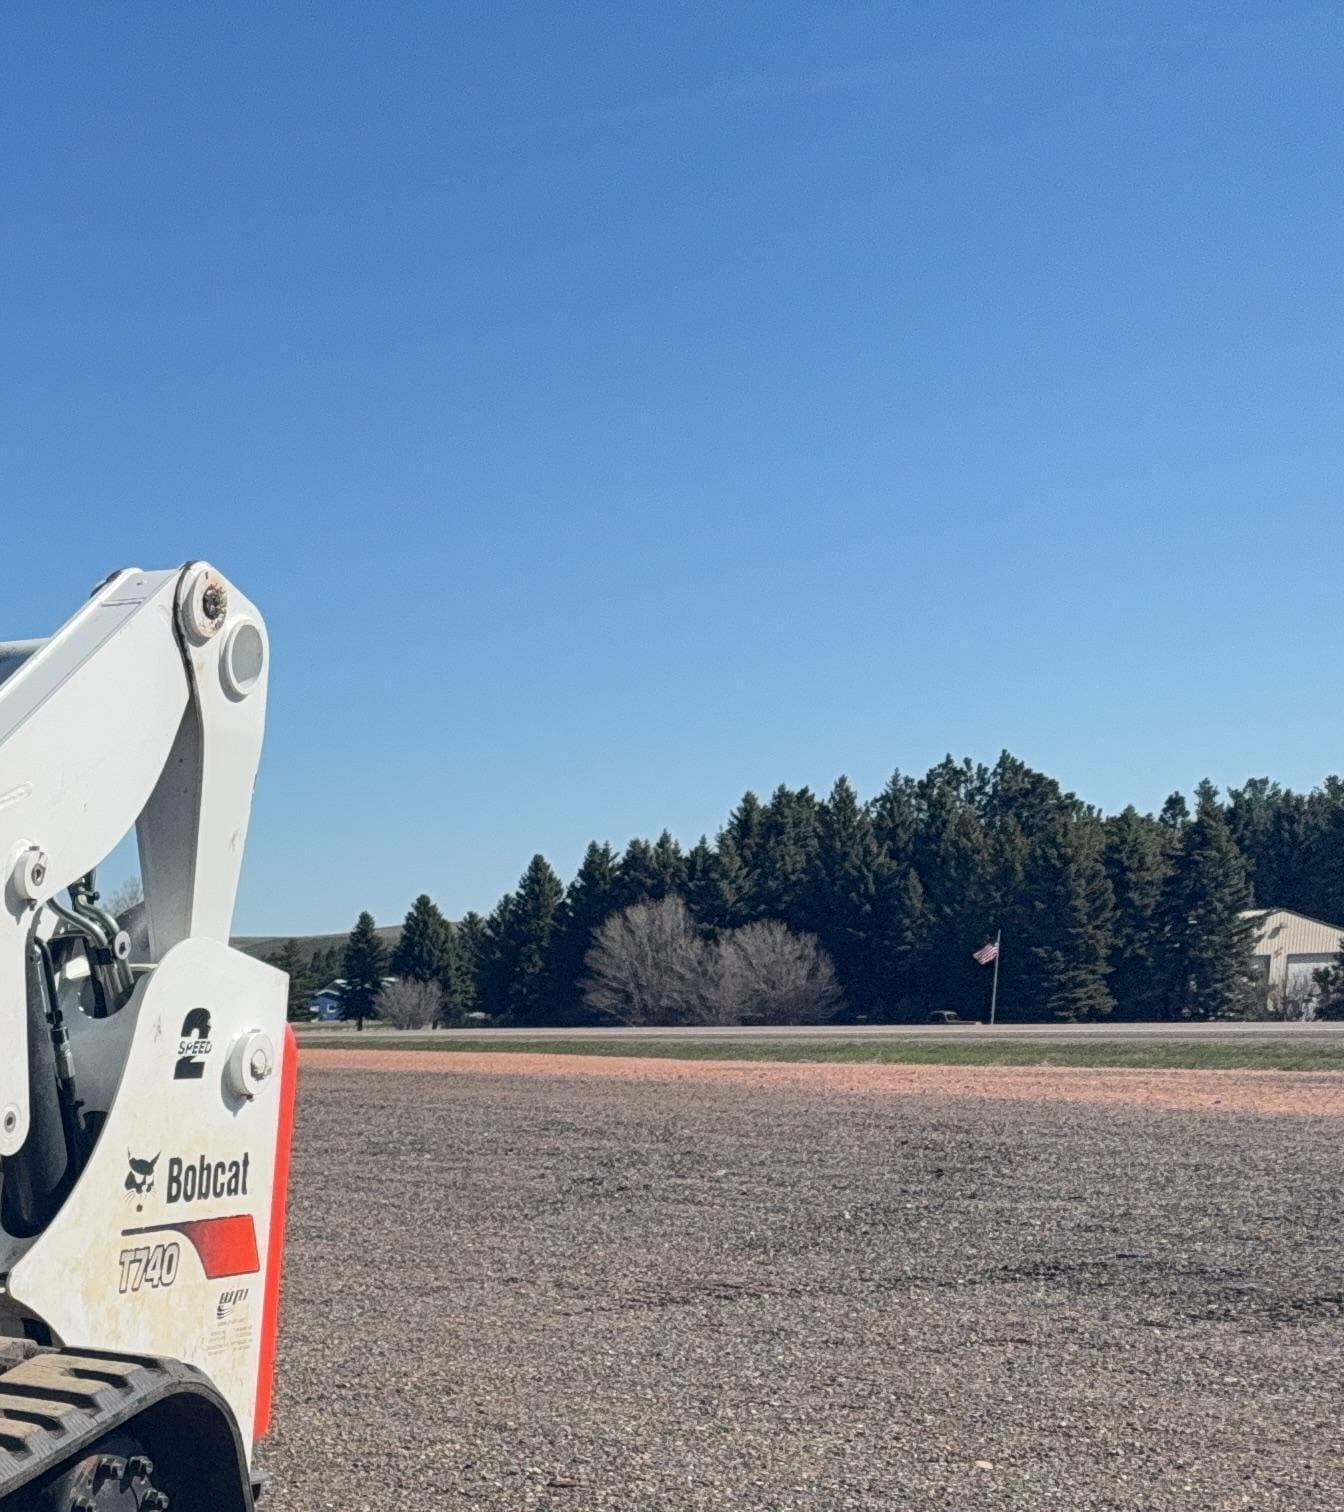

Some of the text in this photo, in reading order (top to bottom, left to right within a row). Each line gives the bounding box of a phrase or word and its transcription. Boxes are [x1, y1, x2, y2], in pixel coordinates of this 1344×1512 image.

[173, 1008, 211, 1080] 2
[177, 1041, 212, 1055] SPEED
[166, 1152, 250, 1204] Bobcat
[119, 1242, 180, 1294] T740
